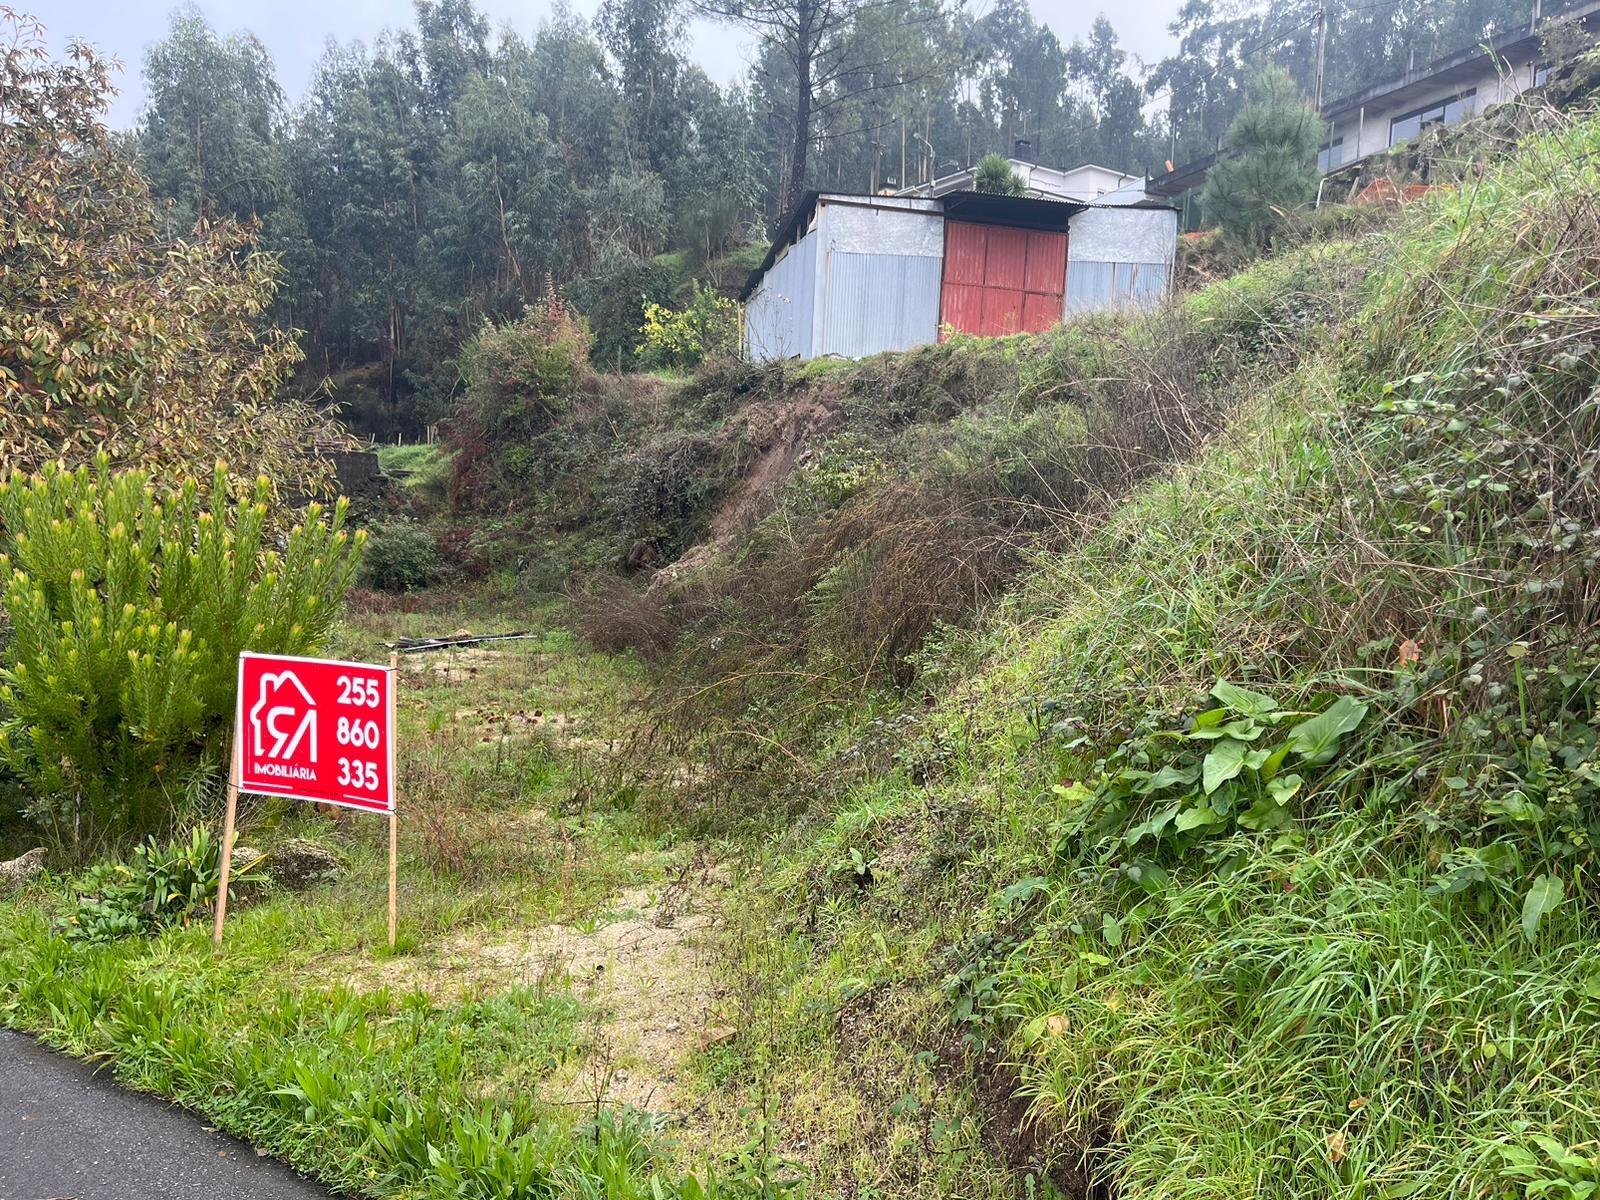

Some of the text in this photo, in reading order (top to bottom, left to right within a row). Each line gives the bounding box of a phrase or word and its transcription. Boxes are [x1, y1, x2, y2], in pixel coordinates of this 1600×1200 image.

[336, 675, 380, 708] 255
[336, 716, 380, 750] 860
[254, 763, 317, 781] IMOBILIÁRIA
[337, 757, 379, 791] 335
